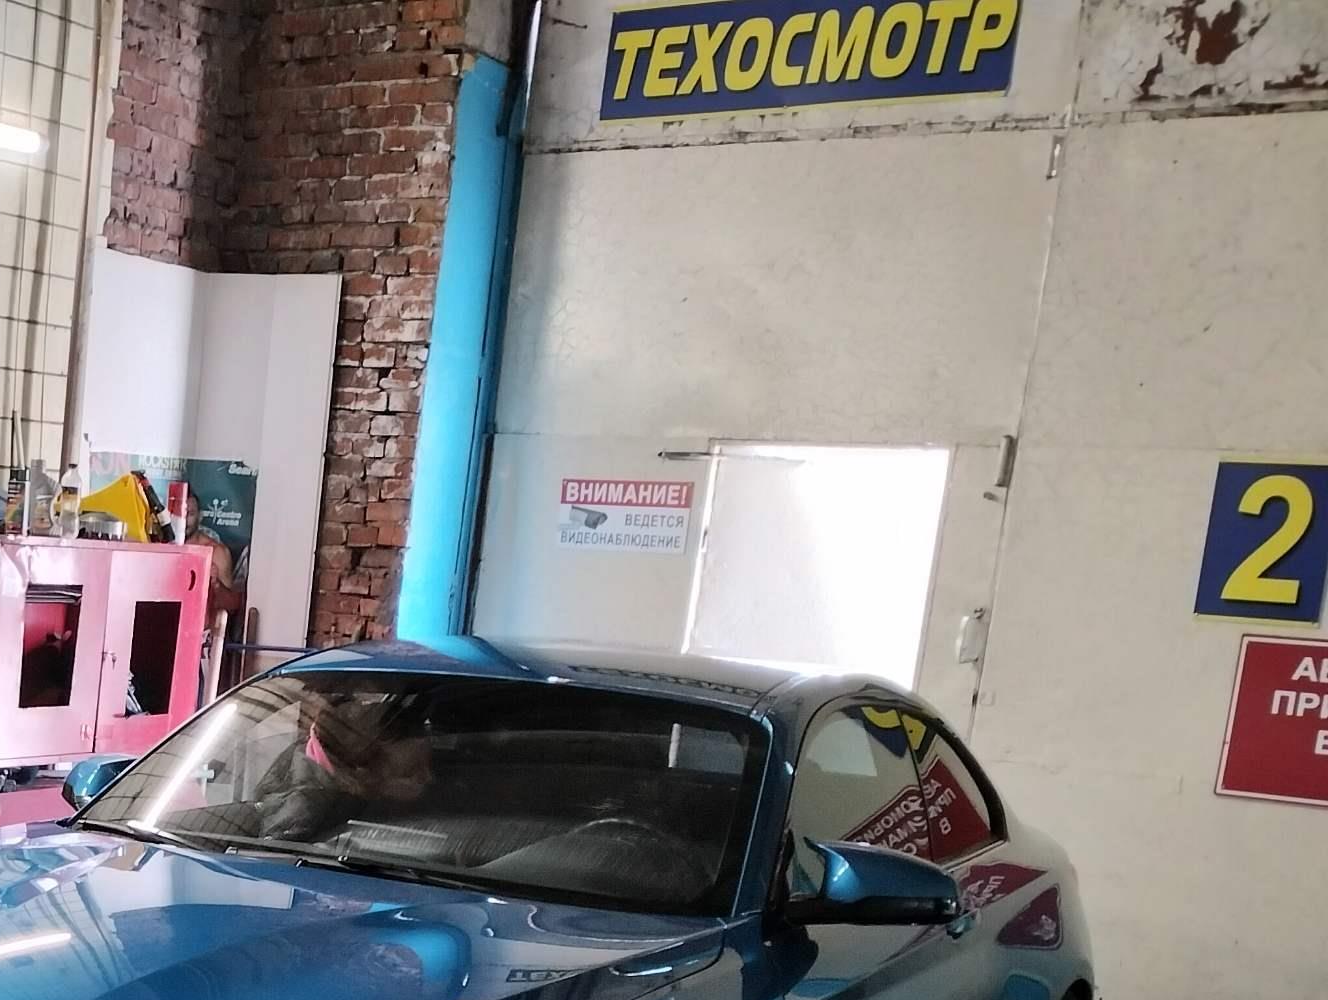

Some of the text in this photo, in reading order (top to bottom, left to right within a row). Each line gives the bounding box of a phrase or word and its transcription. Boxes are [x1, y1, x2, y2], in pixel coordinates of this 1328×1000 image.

[613, 0, 1017, 100] ТЕХОСМОТР
[565, 482, 688, 505] ВНИМАНИЕ!
[624, 513, 684, 529] ВЕДЕТСЯ
[560, 530, 681, 549] ВИДЕОНАБЛЮДЕНИЕ
[1220, 474, 1313, 604] 2
